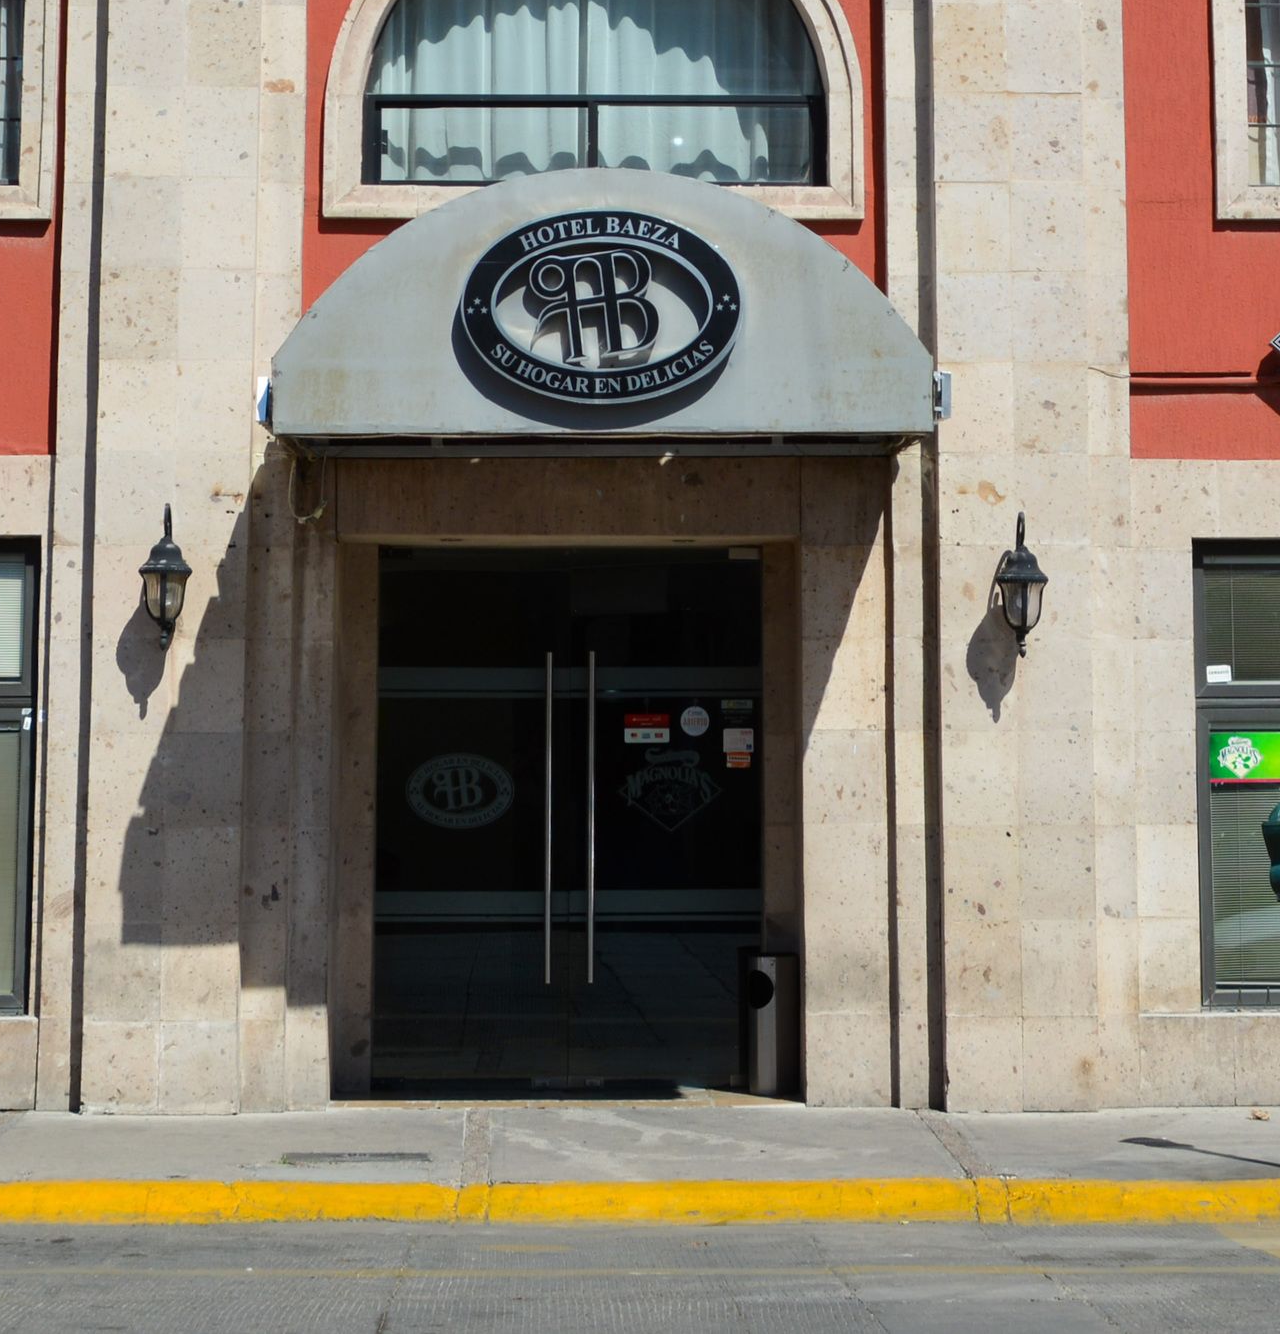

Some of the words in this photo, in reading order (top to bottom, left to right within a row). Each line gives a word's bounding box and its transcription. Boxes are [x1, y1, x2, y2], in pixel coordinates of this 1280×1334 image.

[519, 219, 600, 251] HOTEL
[605, 217, 680, 250] BAEZA
[491, 343, 517, 367] SU
[515, 360, 589, 393] HOGAR
[595, 378, 621, 393] EN
[627, 340, 714, 391] DELICIAS
